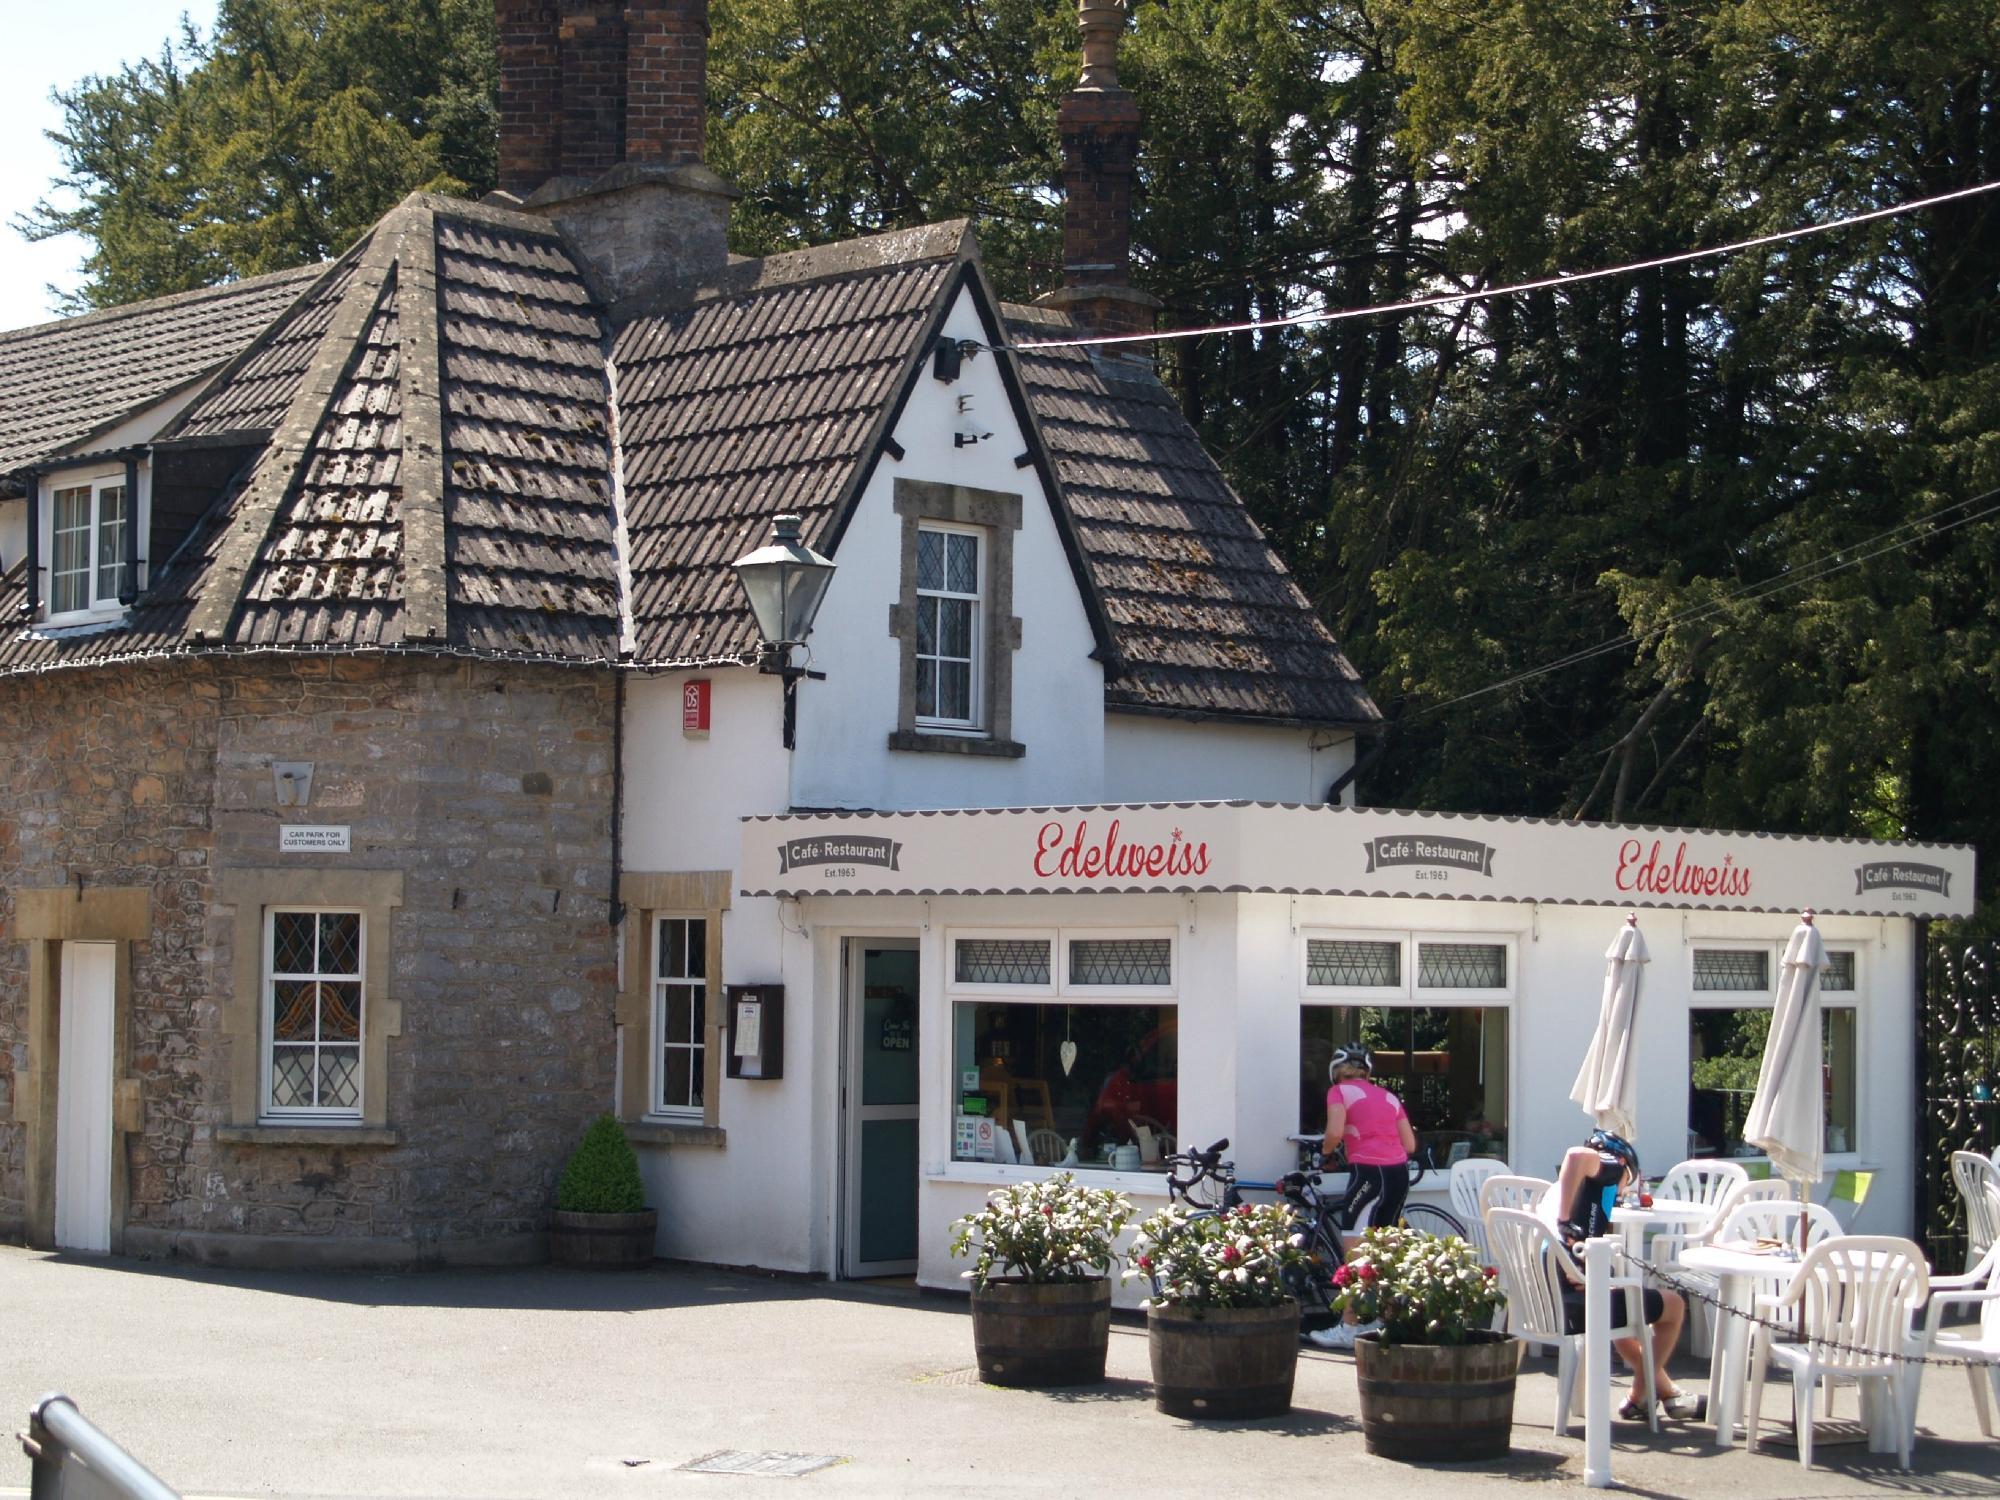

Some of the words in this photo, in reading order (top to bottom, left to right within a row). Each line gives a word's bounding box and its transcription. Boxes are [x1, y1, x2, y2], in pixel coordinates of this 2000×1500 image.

[791, 844, 819, 860] Café
[824, 842, 886, 860] Restaurant
[1033, 819, 1213, 879] Edelweiss
[1379, 842, 1409, 859] Café
[1415, 841, 1480, 864] Restaurant
[1615, 839, 1752, 897] Edelweiss
[1865, 868, 1889, 882] Café
[1892, 867, 1941, 886] Restaurant
[883, 1036, 909, 1049] OPEN
